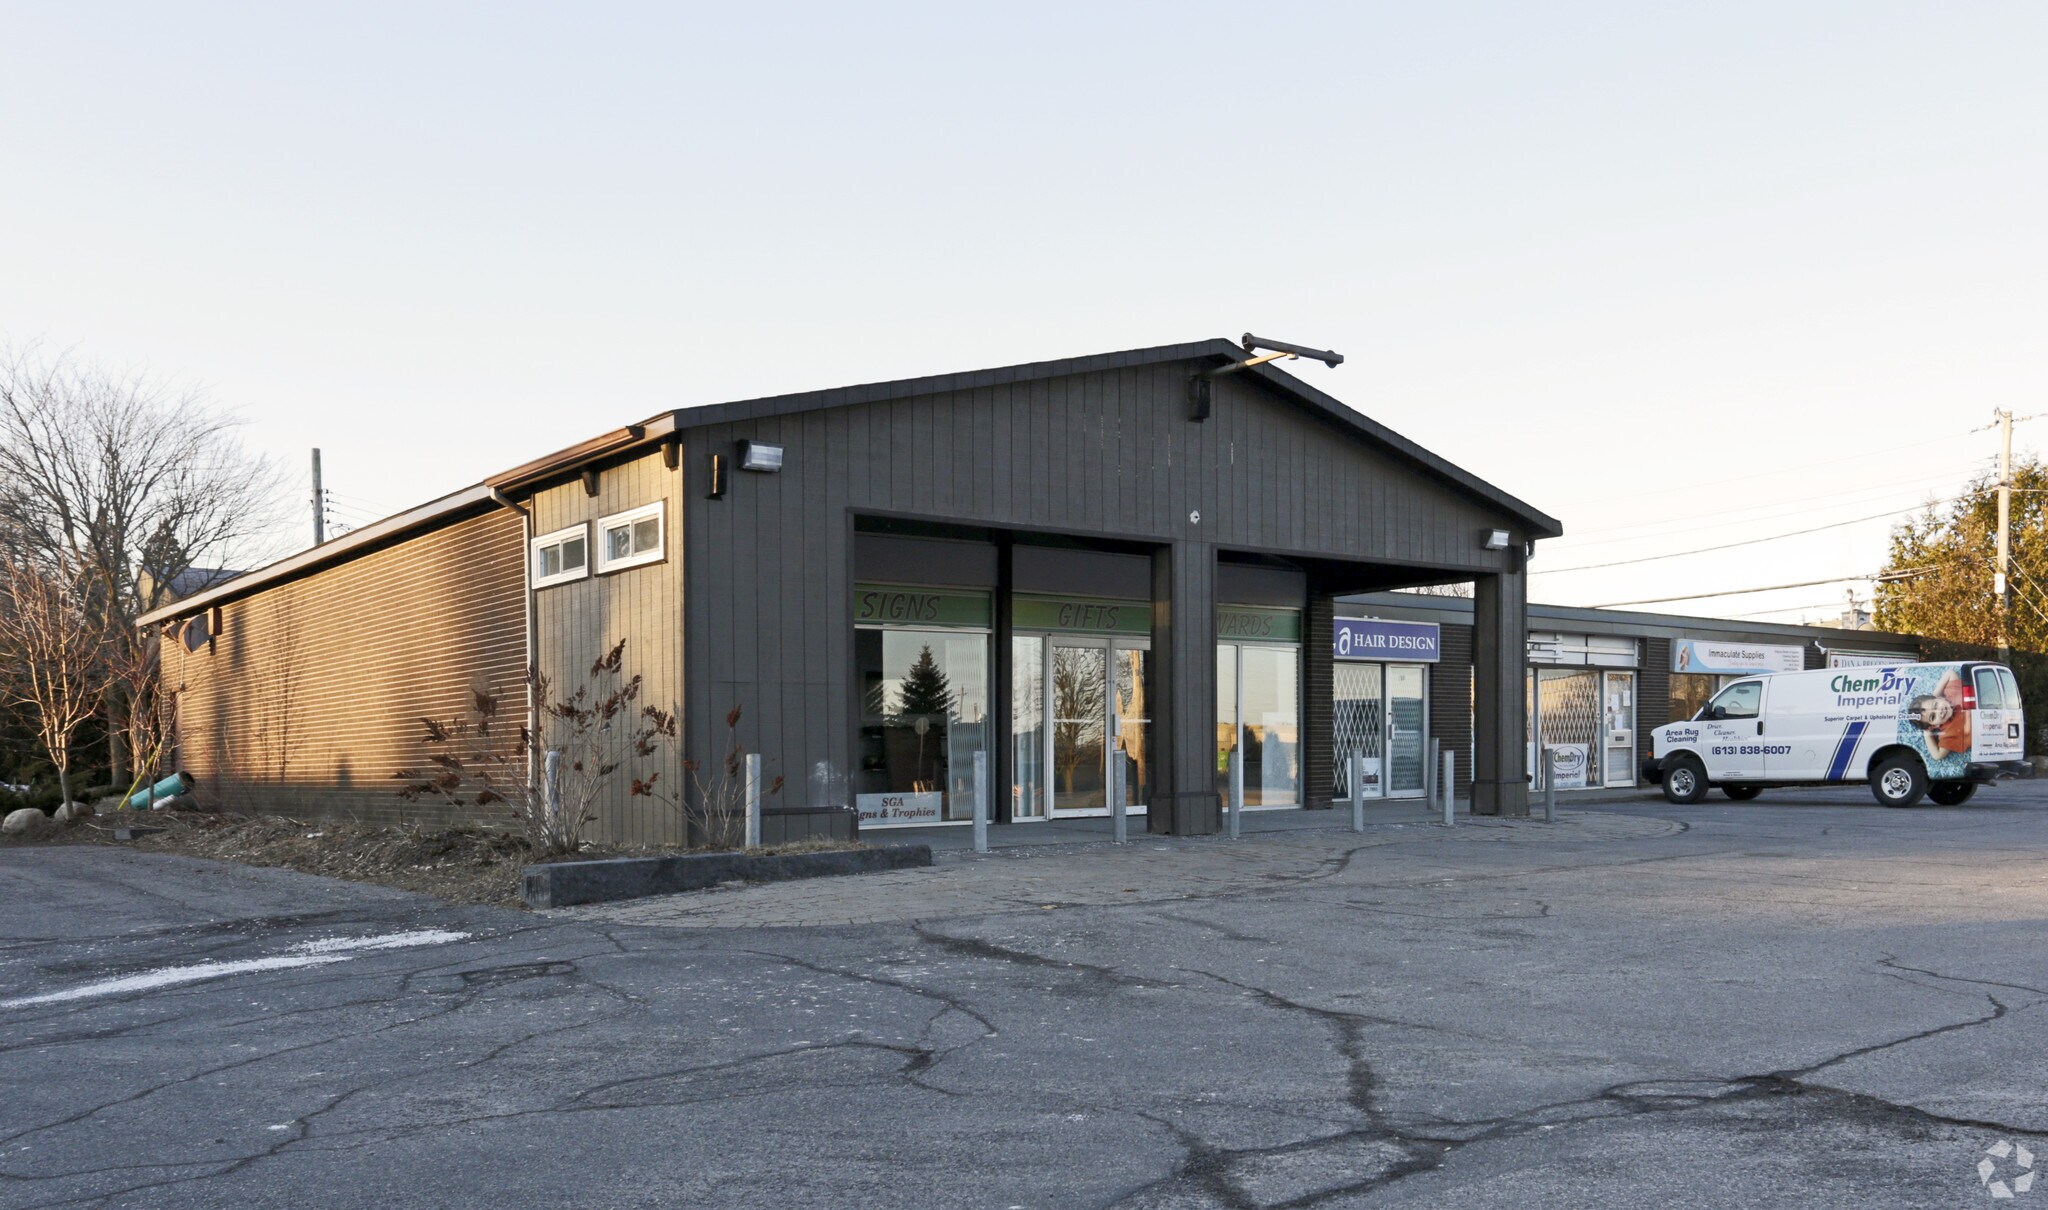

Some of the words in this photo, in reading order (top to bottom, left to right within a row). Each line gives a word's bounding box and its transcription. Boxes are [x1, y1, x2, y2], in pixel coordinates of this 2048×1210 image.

[861, 592, 940, 620] SIGNS
[1059, 603, 1120, 629] GIFTS
[1217, 613, 1275, 636] WARDS
[1354, 633, 1386, 648] HAIR
[1389, 635, 1435, 650] DESIGN
[1708, 649, 1741, 659] Immaculate
[1741, 650, 1765, 661] Supplies
[1837, 692, 1902, 709] Imperial
[1665, 729, 1683, 737] Area
[1684, 728, 1699, 737] Rug
[1666, 735, 1698, 743] Cleaning
[1711, 746, 1737, 755] (613)
[1739, 745, 1792, 755] 838-6007
[881, 797, 904, 807] SGA
[880, 808, 889, 818] &
[892, 807, 936, 819] Trophies
